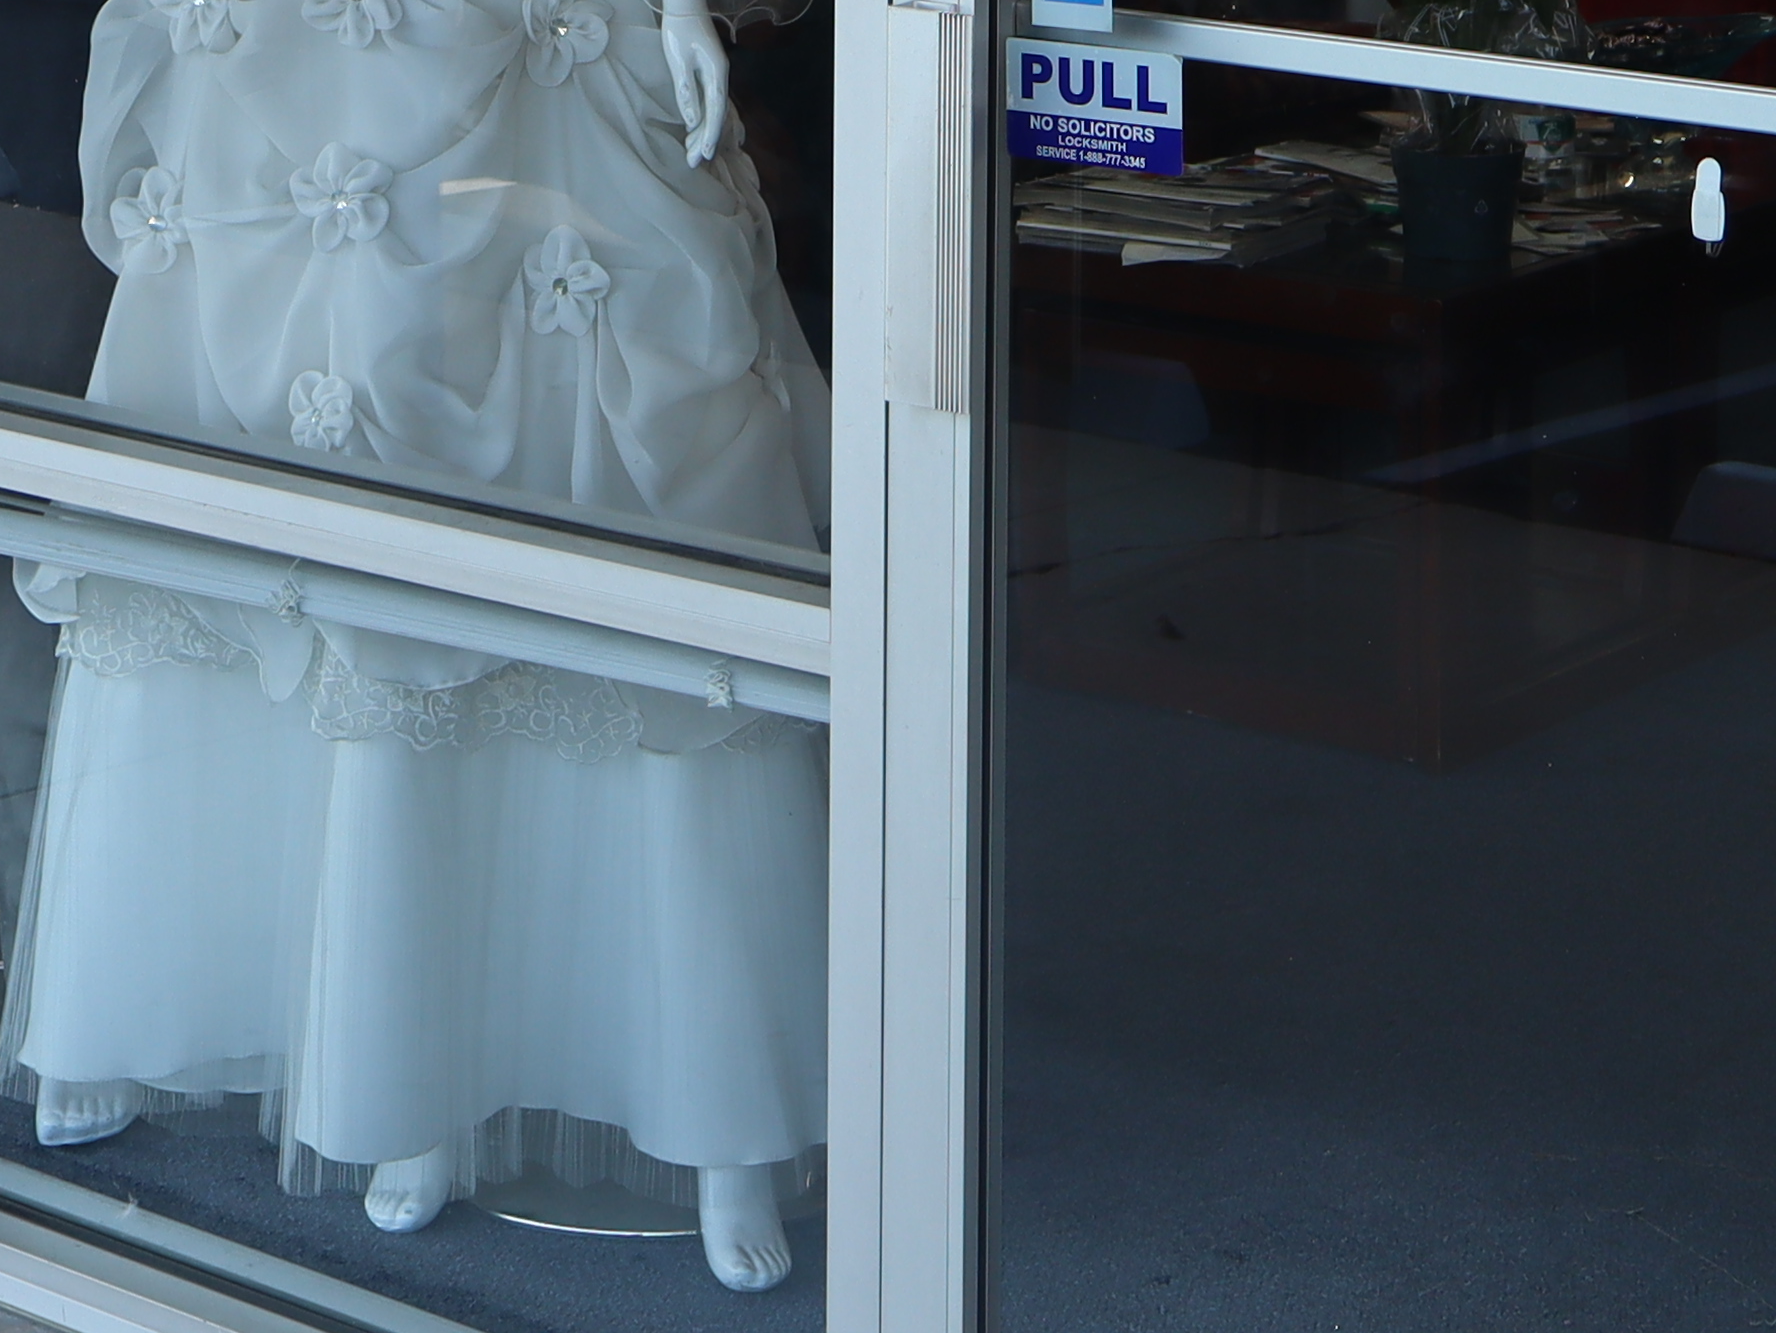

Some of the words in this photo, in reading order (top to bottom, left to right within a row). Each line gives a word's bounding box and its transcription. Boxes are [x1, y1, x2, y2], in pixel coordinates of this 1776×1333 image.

[1021, 52, 1168, 115] PULL
[1029, 114, 1054, 131] NO
[1057, 117, 1155, 144] SOLICITORS
[1036, 144, 1077, 161] SERVICE
[1078, 151, 1146, 169] 1-888-777-3345
[1058, 134, 1127, 153] LOCKSMITH
